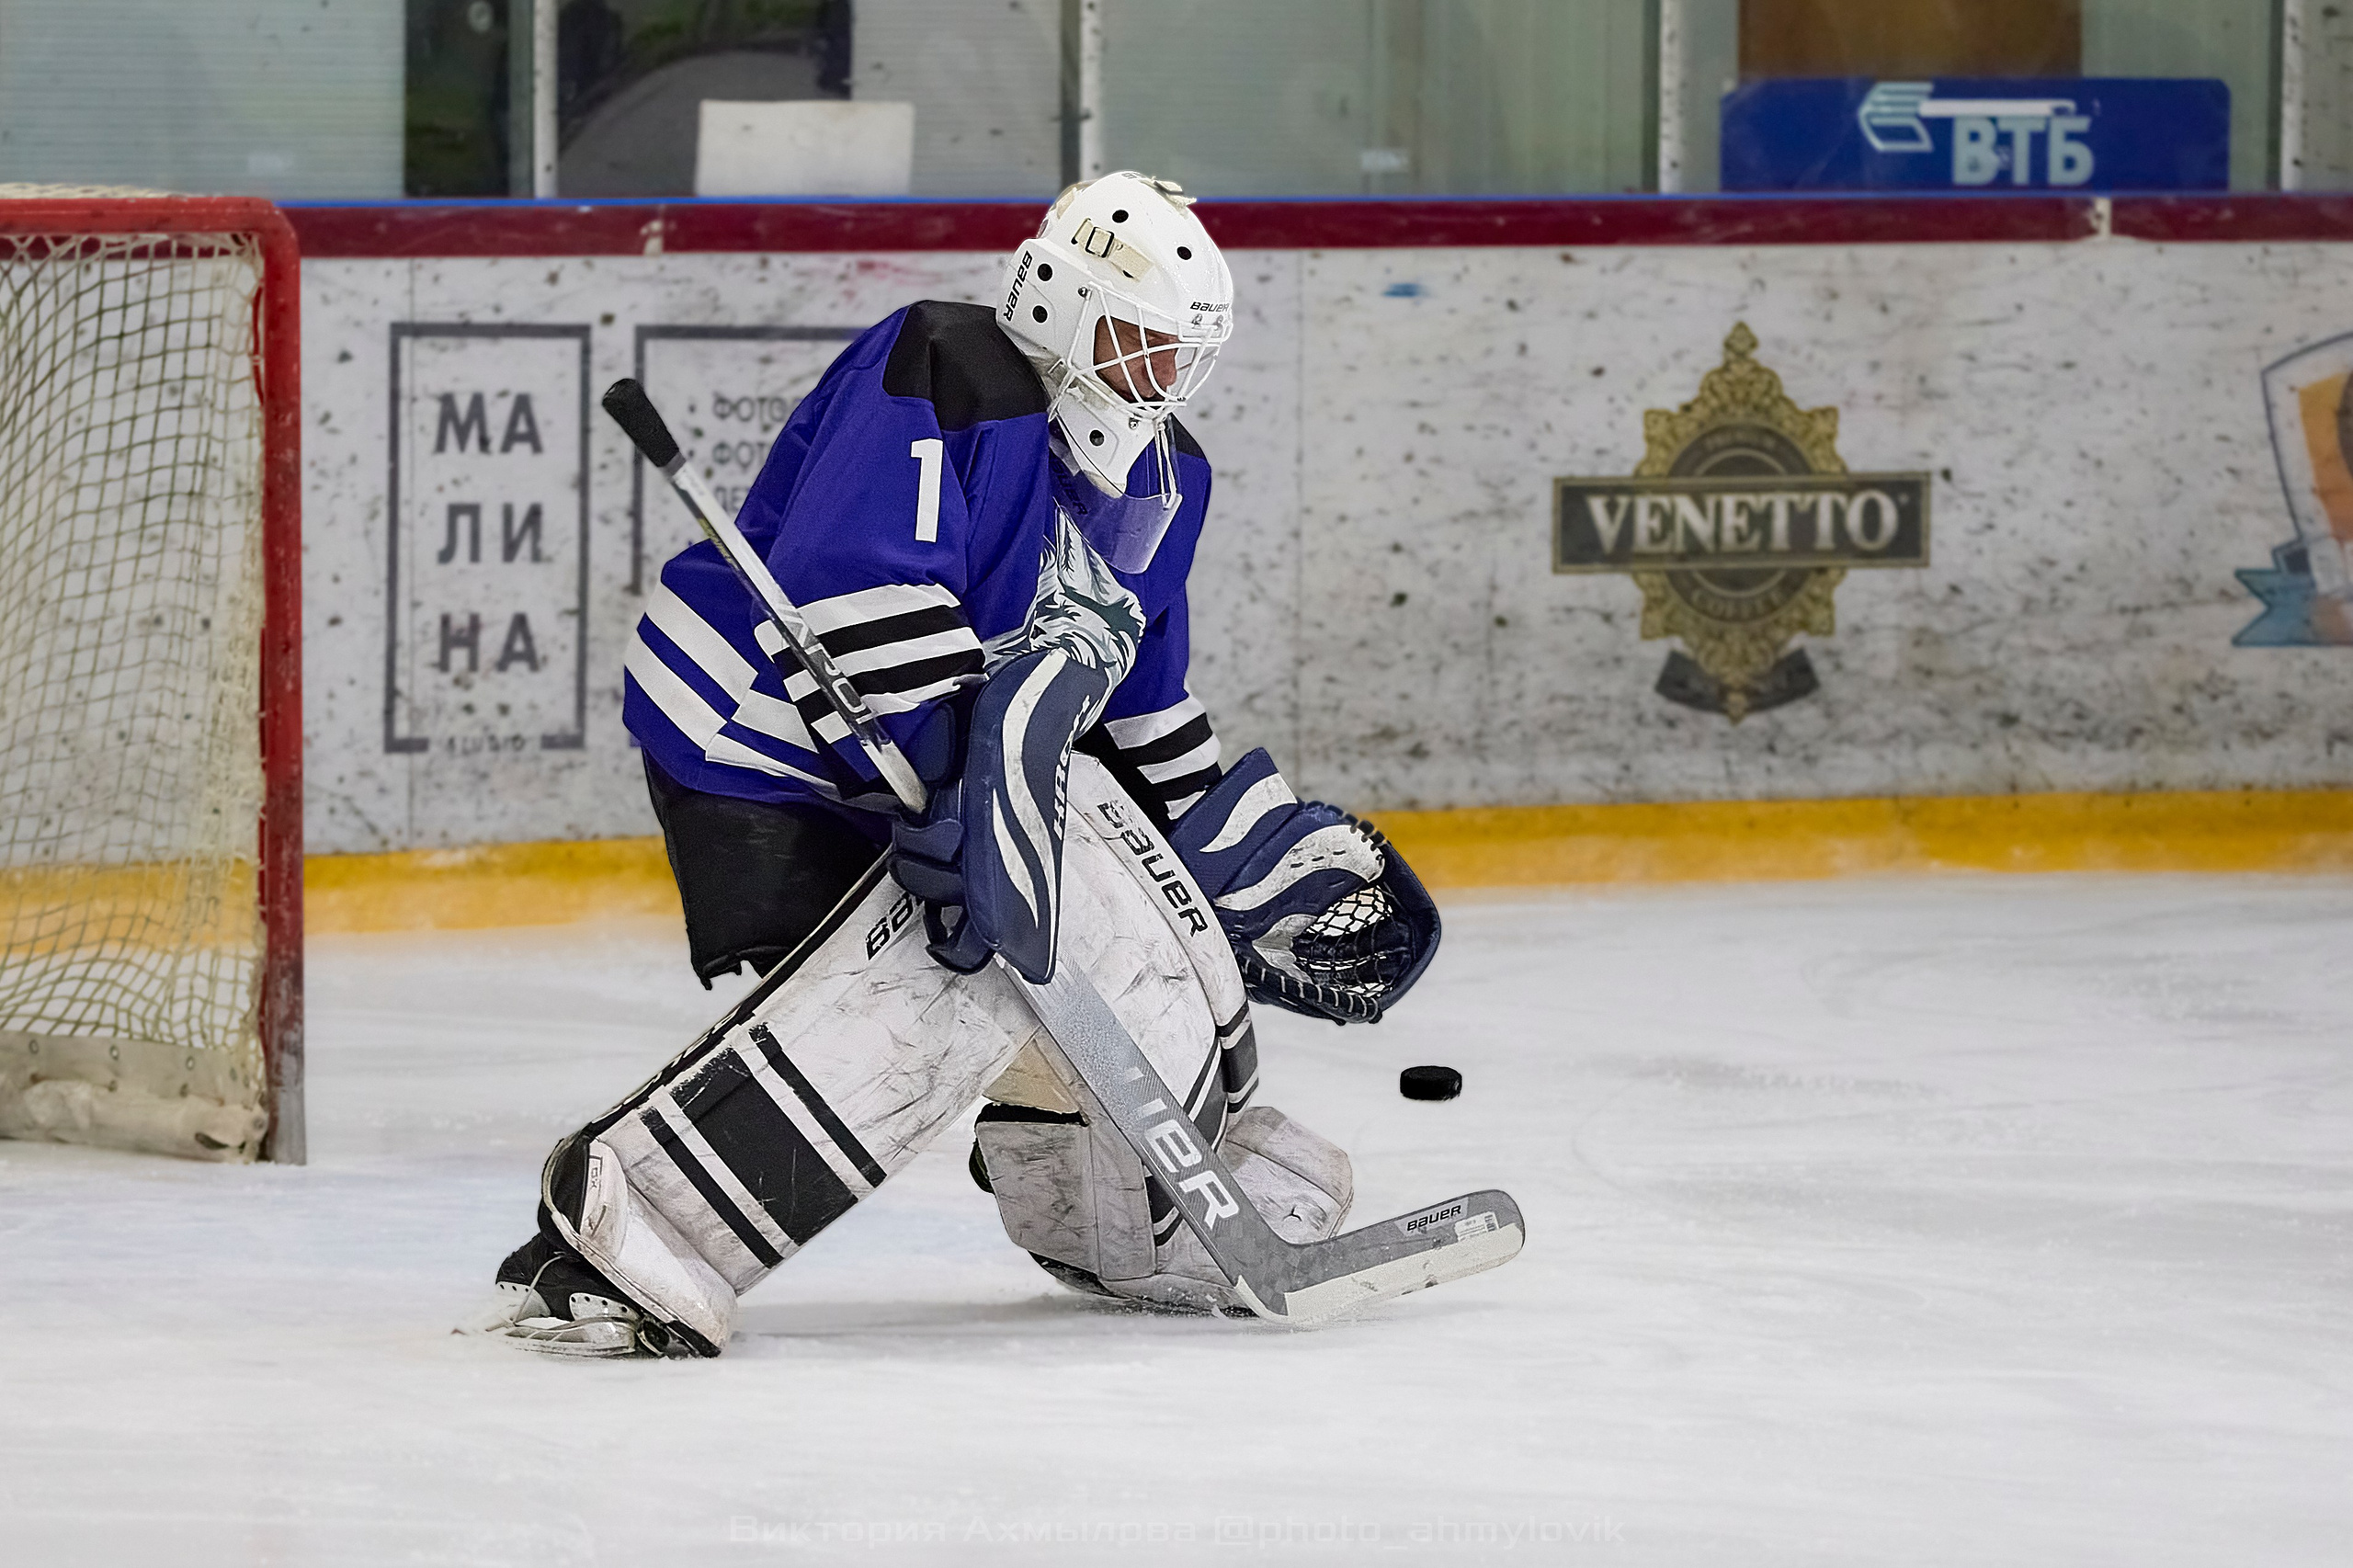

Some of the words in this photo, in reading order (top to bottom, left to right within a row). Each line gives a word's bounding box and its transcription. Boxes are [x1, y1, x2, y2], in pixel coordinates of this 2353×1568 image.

[1951, 117, 2094, 185] ВТБ
[1003, 250, 1033, 322] BAUER
[1189, 301, 1230, 312] BAUER
[911, 438, 944, 543] 1
[1586, 490, 1900, 553] VENETTO
[1097, 800, 1209, 938] BAUER
[1406, 1203, 1462, 1233] BAUER
